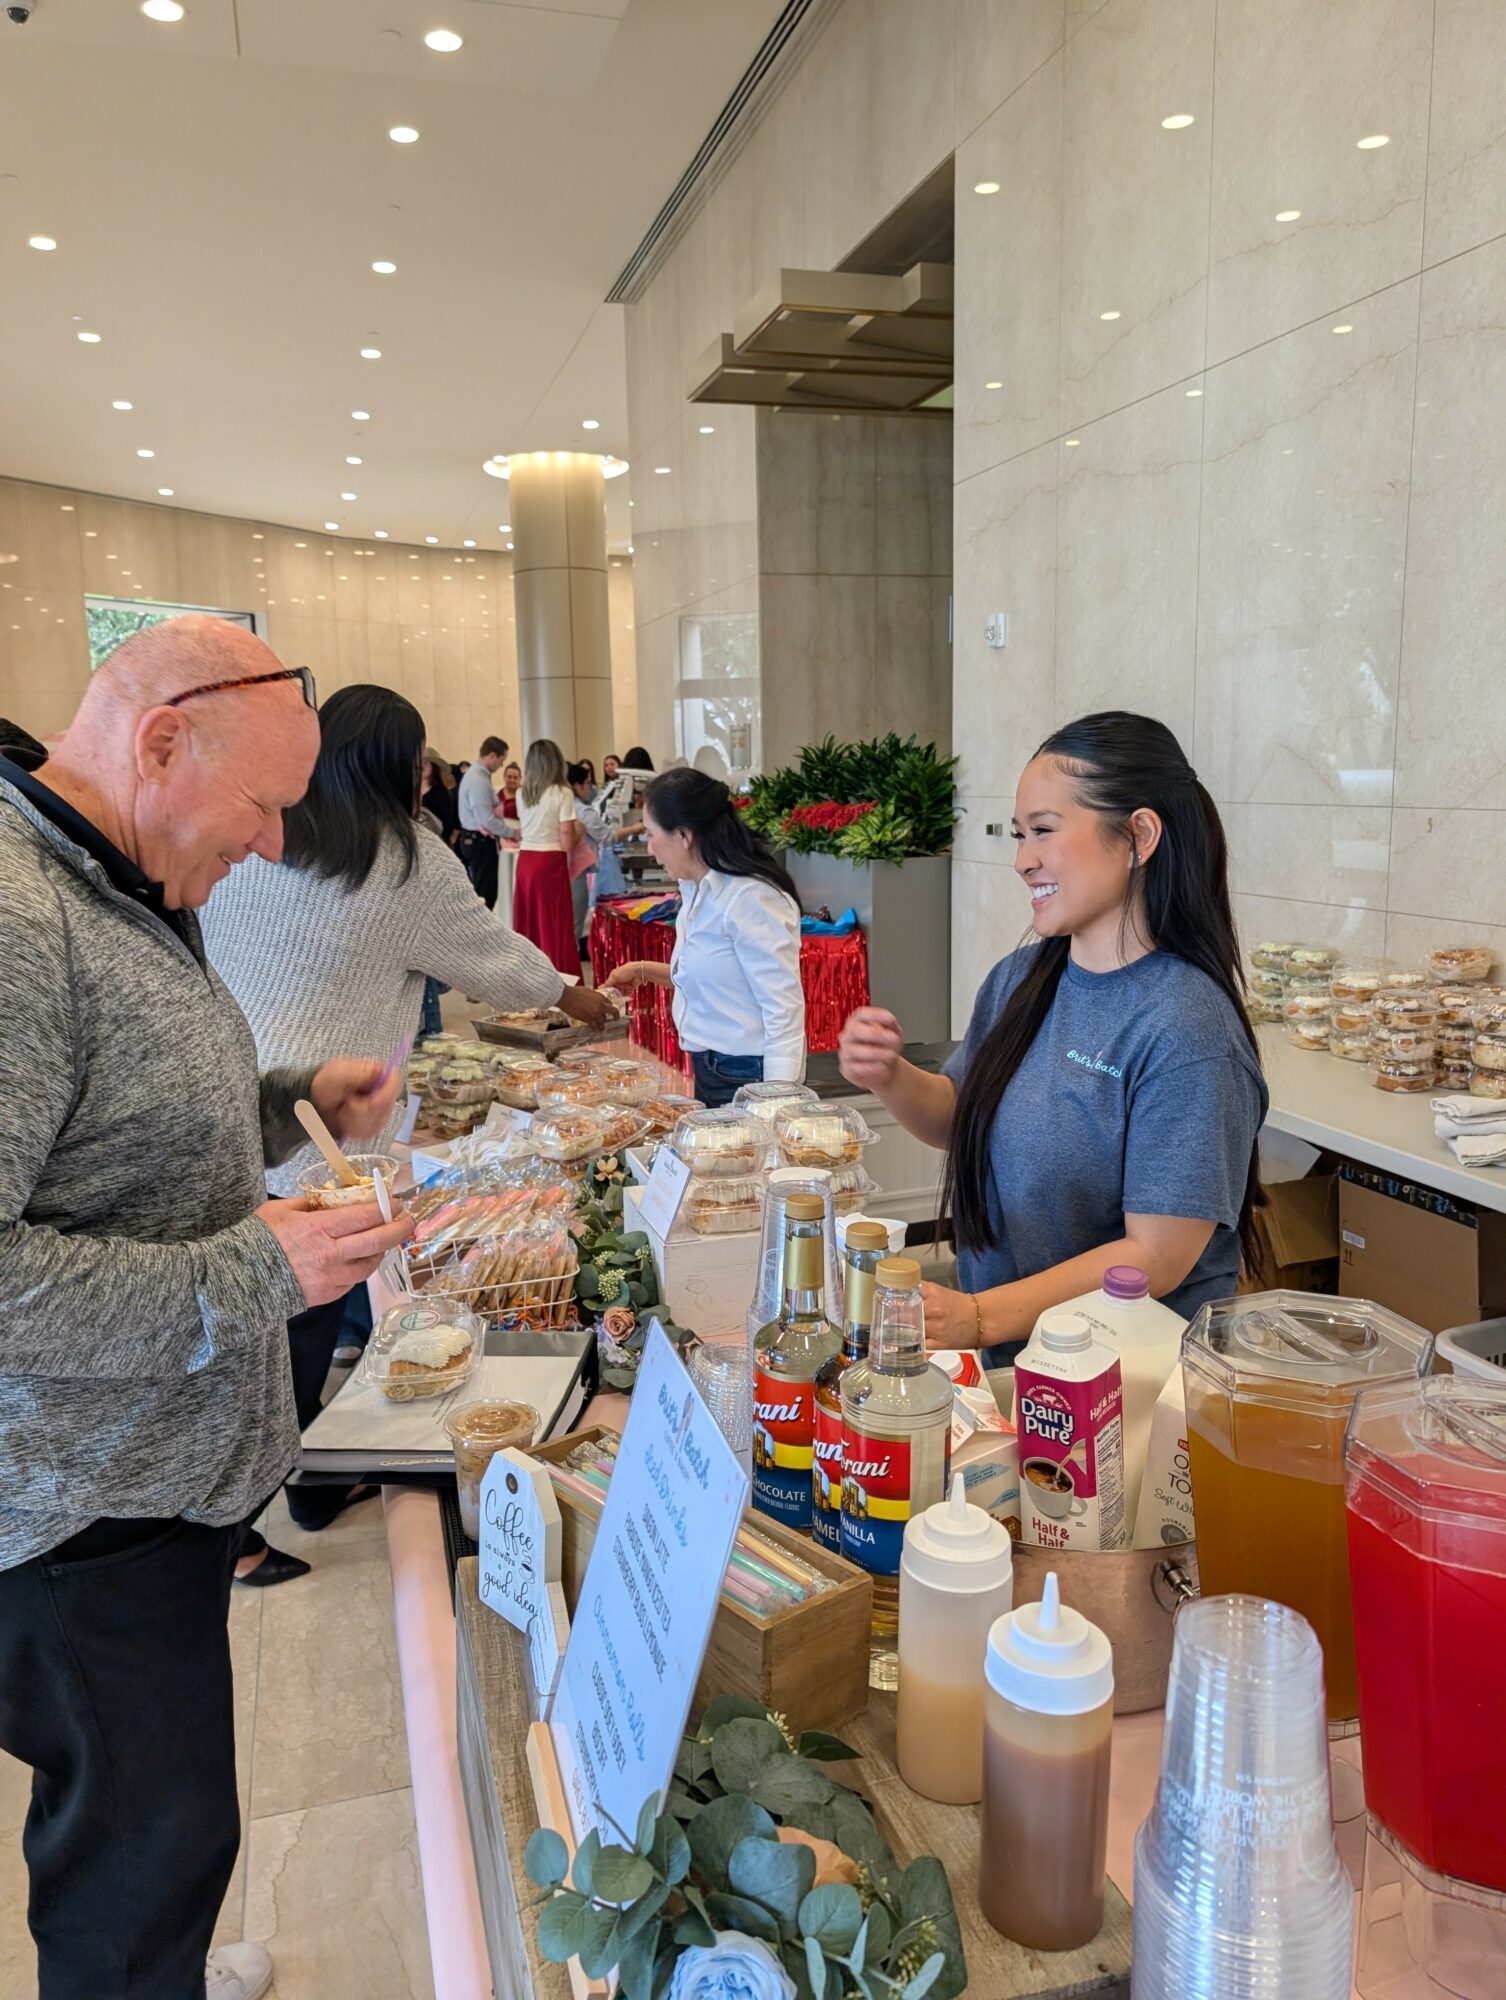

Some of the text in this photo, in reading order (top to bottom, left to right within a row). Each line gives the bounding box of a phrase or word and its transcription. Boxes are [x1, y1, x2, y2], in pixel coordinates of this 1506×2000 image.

[1066, 1049, 1092, 1068] Brit's
[752, 1396, 802, 1422] rani
[1020, 1397, 1074, 1433] Dairy
[1025, 1416, 1071, 1446] Pure
[684, 1430, 710, 1490] Batch
[841, 1447, 891, 1477] orani
[752, 1471, 807, 1502] CHOCOLATE
[1167, 1471, 1193, 1498] TO
[485, 1488, 535, 1556] Coffee
[1032, 1516, 1070, 1541] Half &
[654, 1531, 670, 1574] LATTE
[1037, 1532, 1065, 1549] Half
[493, 1548, 516, 1568] always
[482, 1570, 539, 1619] good idea
[612, 1534, 637, 1602] STRAWBERRY
[642, 1614, 667, 1683] LEMONADE
[593, 1594, 645, 1761] Cinnamon Rolls
